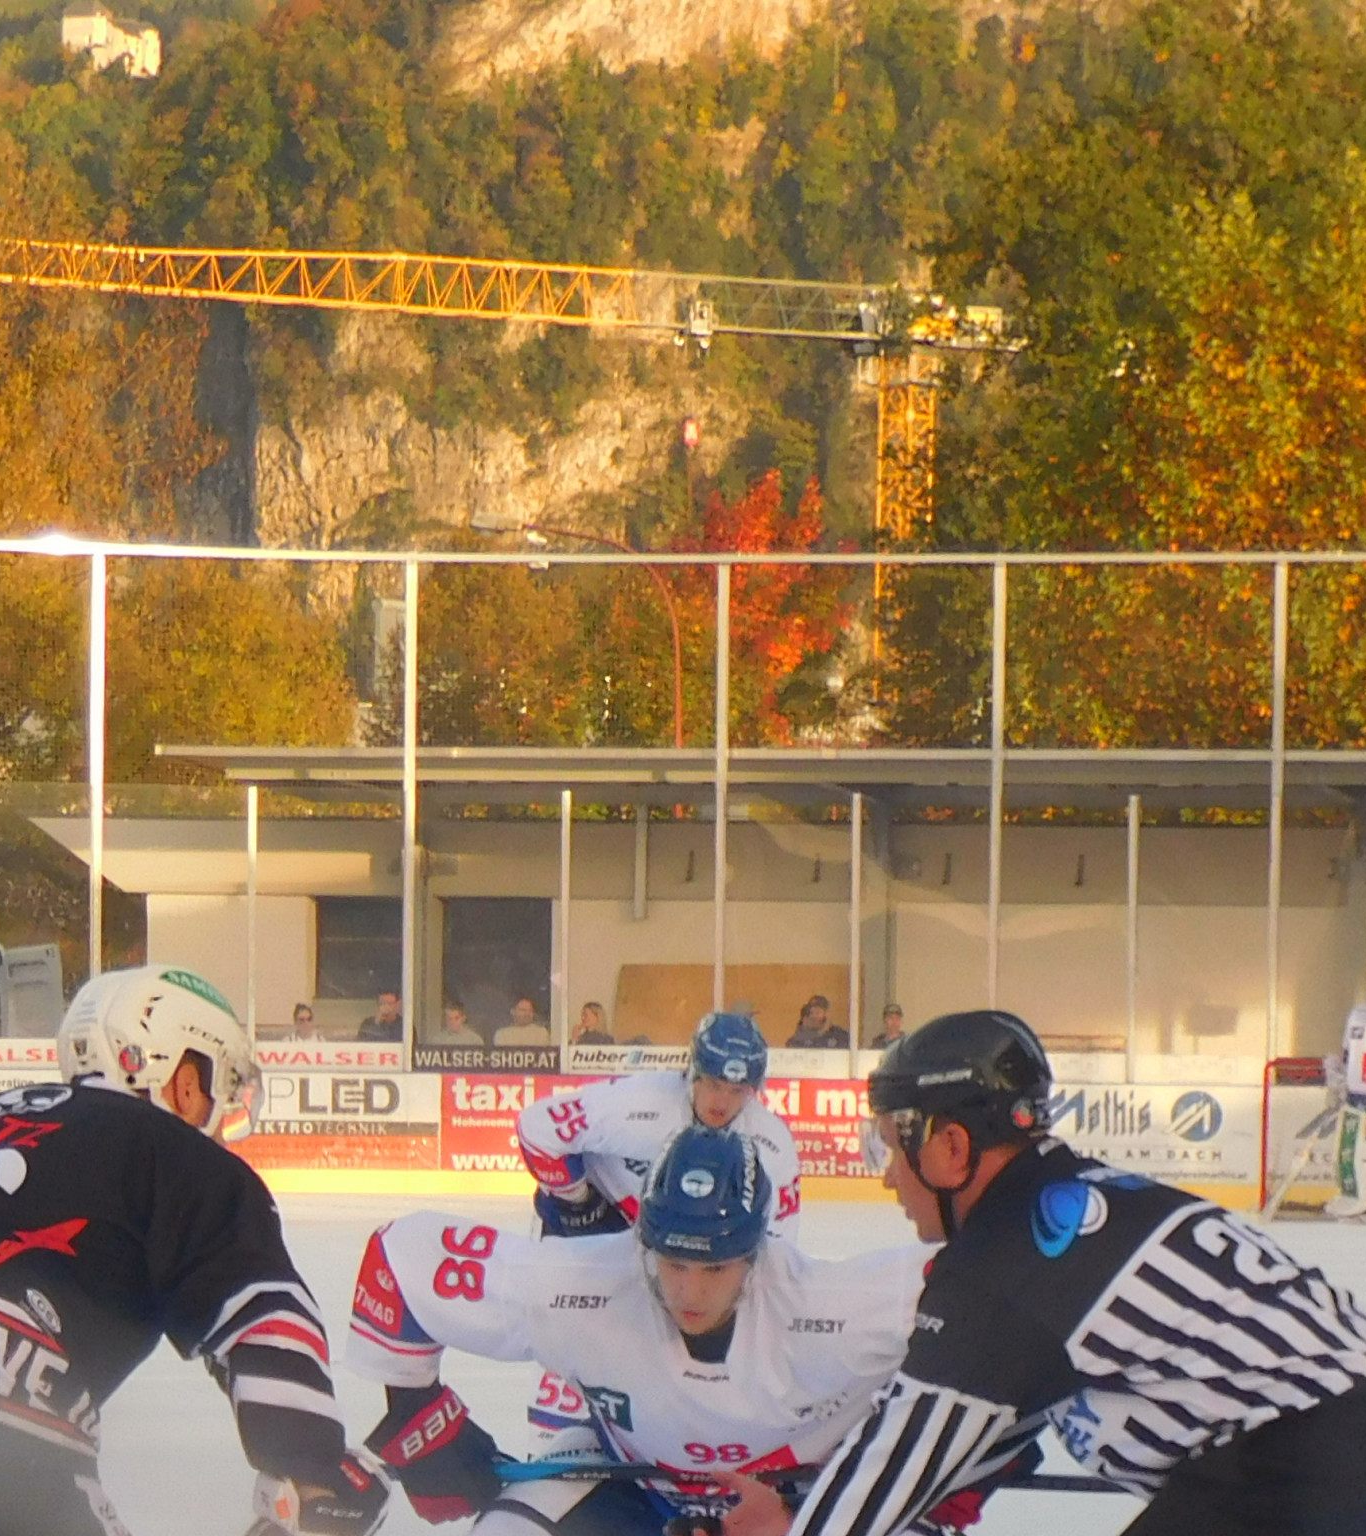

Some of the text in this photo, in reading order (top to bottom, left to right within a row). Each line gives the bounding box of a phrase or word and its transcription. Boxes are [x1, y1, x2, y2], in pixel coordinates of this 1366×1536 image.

[257, 1051, 400, 1066] WALSER
[414, 1050, 557, 1069] WALSER-SHOP.AT
[572, 1050, 691, 1064] huber munt
[451, 1077, 535, 1112] taxi
[1124, 1150, 1151, 1160] AM
[1166, 1150, 1223, 1161] DACH
[431, 1224, 499, 1303] 98
[683, 1441, 752, 1465] 98
